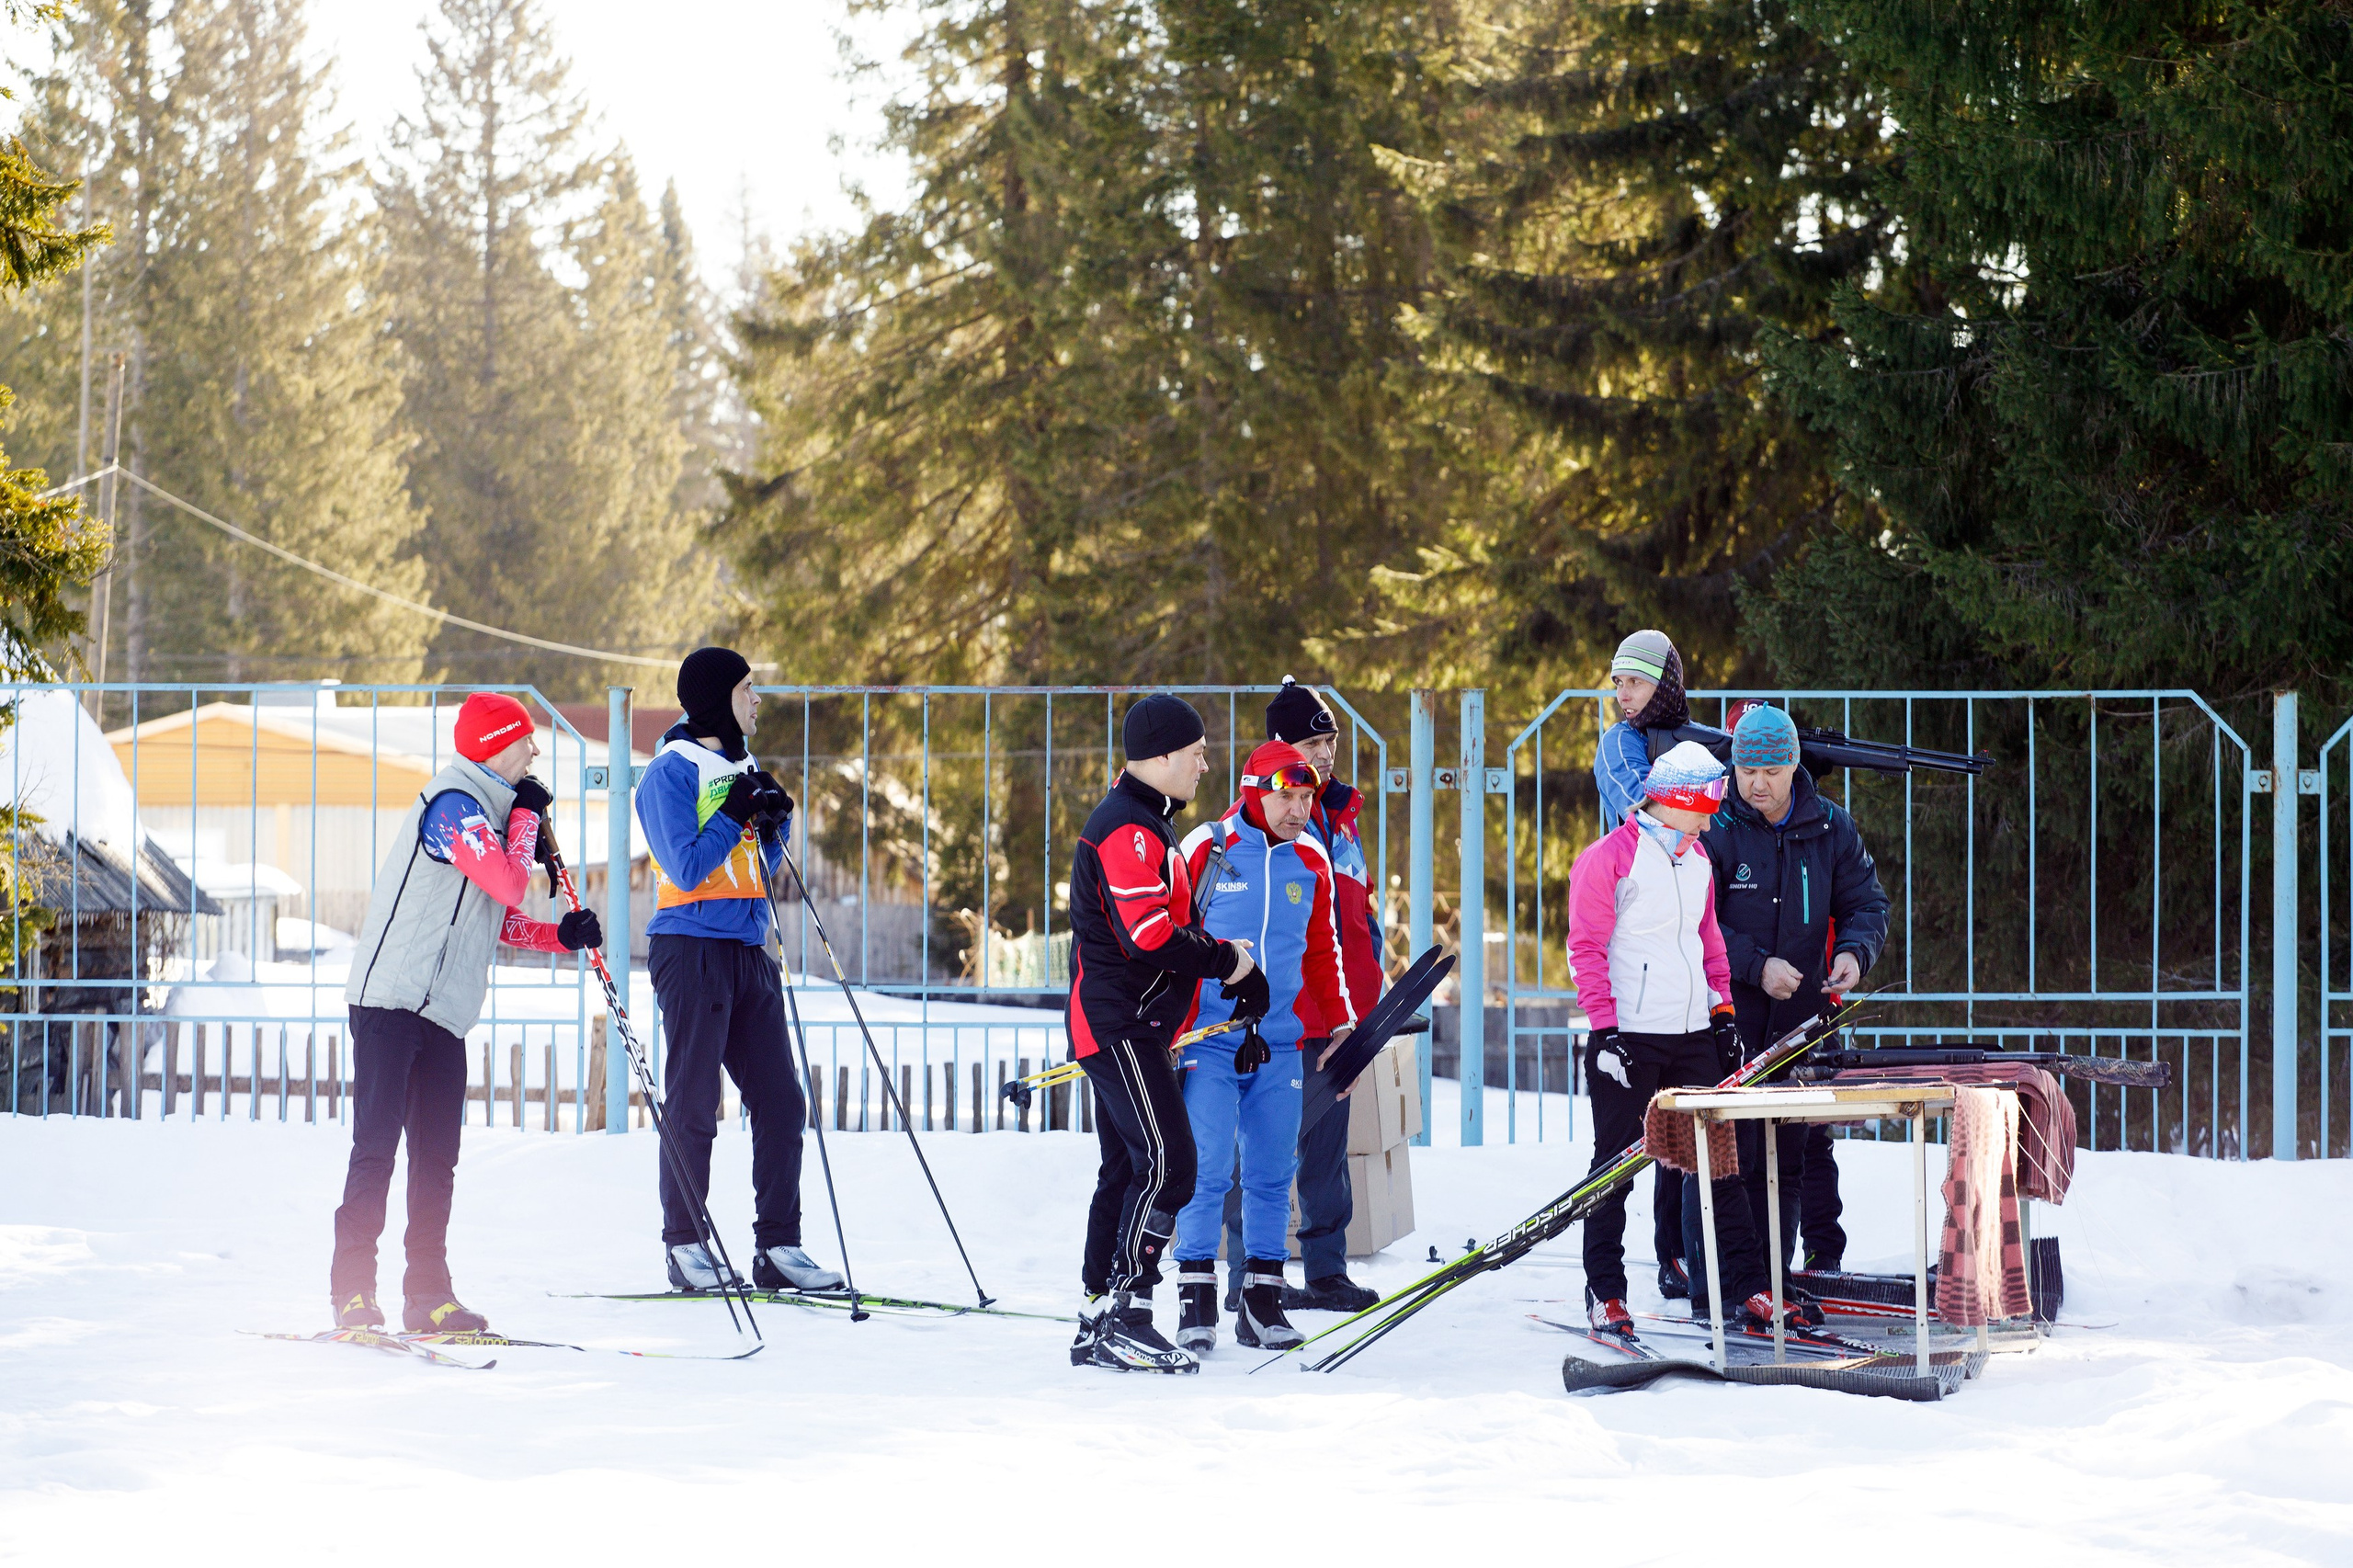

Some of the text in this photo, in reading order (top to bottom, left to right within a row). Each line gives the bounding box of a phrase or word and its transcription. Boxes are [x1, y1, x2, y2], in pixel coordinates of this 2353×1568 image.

[479, 720, 522, 744] NORDSKI
[1215, 881, 1249, 892] SKINSK
[1483, 1196, 1574, 1255] FISCHER
